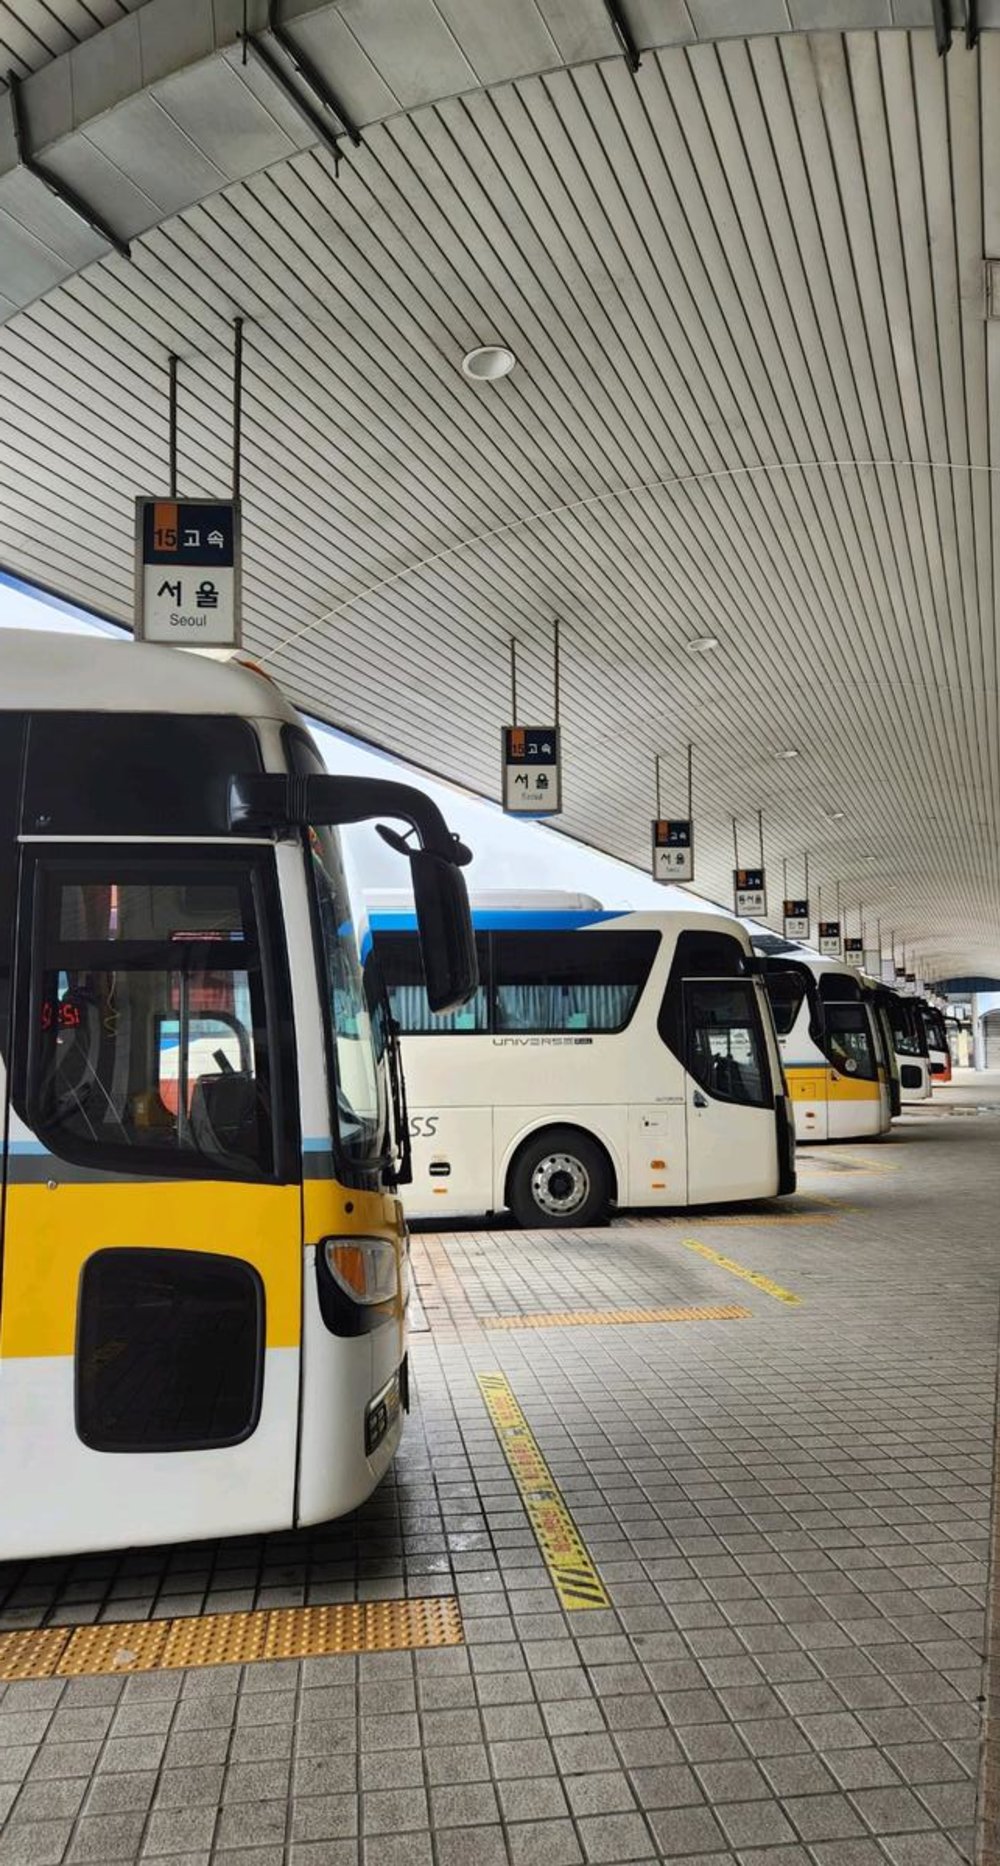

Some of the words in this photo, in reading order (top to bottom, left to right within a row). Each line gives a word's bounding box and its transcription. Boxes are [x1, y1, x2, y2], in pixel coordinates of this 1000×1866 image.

[154, 529, 177, 547] 15
[183, 530, 225, 549] 고속
[157, 580, 220, 609] 서울
[170, 613, 207, 627] Seoul
[514, 773, 549, 790] 서울
